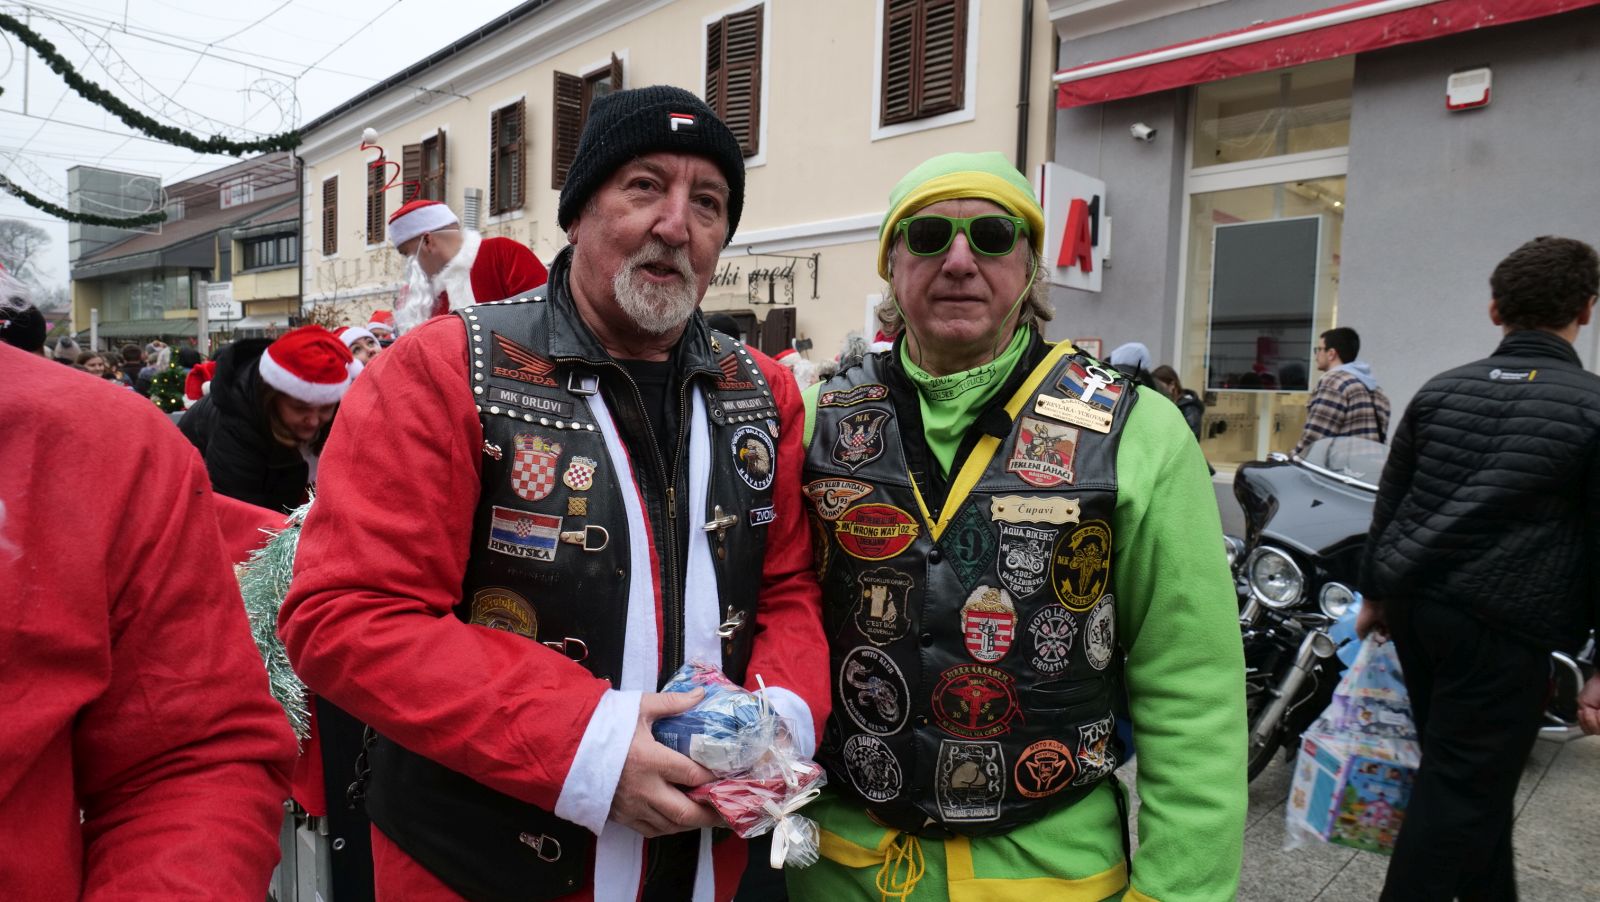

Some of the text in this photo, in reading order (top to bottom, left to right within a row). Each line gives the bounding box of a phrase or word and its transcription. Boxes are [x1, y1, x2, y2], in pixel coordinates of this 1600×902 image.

[1057, 195, 1100, 272] A1
[494, 367, 558, 387] HONDA
[500, 391, 561, 412] MK ORLOVI
[723, 398, 762, 410] MK ORLOVI
[1011, 461, 1041, 470] JEKLENI
[739, 467, 773, 488] HRVATSKA
[825, 481, 840, 489] KLUB
[841, 482, 865, 492] LINDAU
[820, 506, 844, 517] LENDAVA
[1018, 503, 1054, 516] Čupavi
[853, 526, 879, 536] WRONG
[880, 527, 897, 536] WAY
[900, 525, 909, 533] 02
[1003, 527, 1054, 541] AQUA BIKERS
[490, 541, 551, 560] HRVATSKA
[1009, 582, 1034, 592] TOPLICE
[1028, 608, 1078, 635] MOTO LEGIJA
[861, 651, 894, 674] MOTO KLUB
[1032, 656, 1070, 672] CROATIA
[1029, 742, 1064, 751] MOTO KLUB
